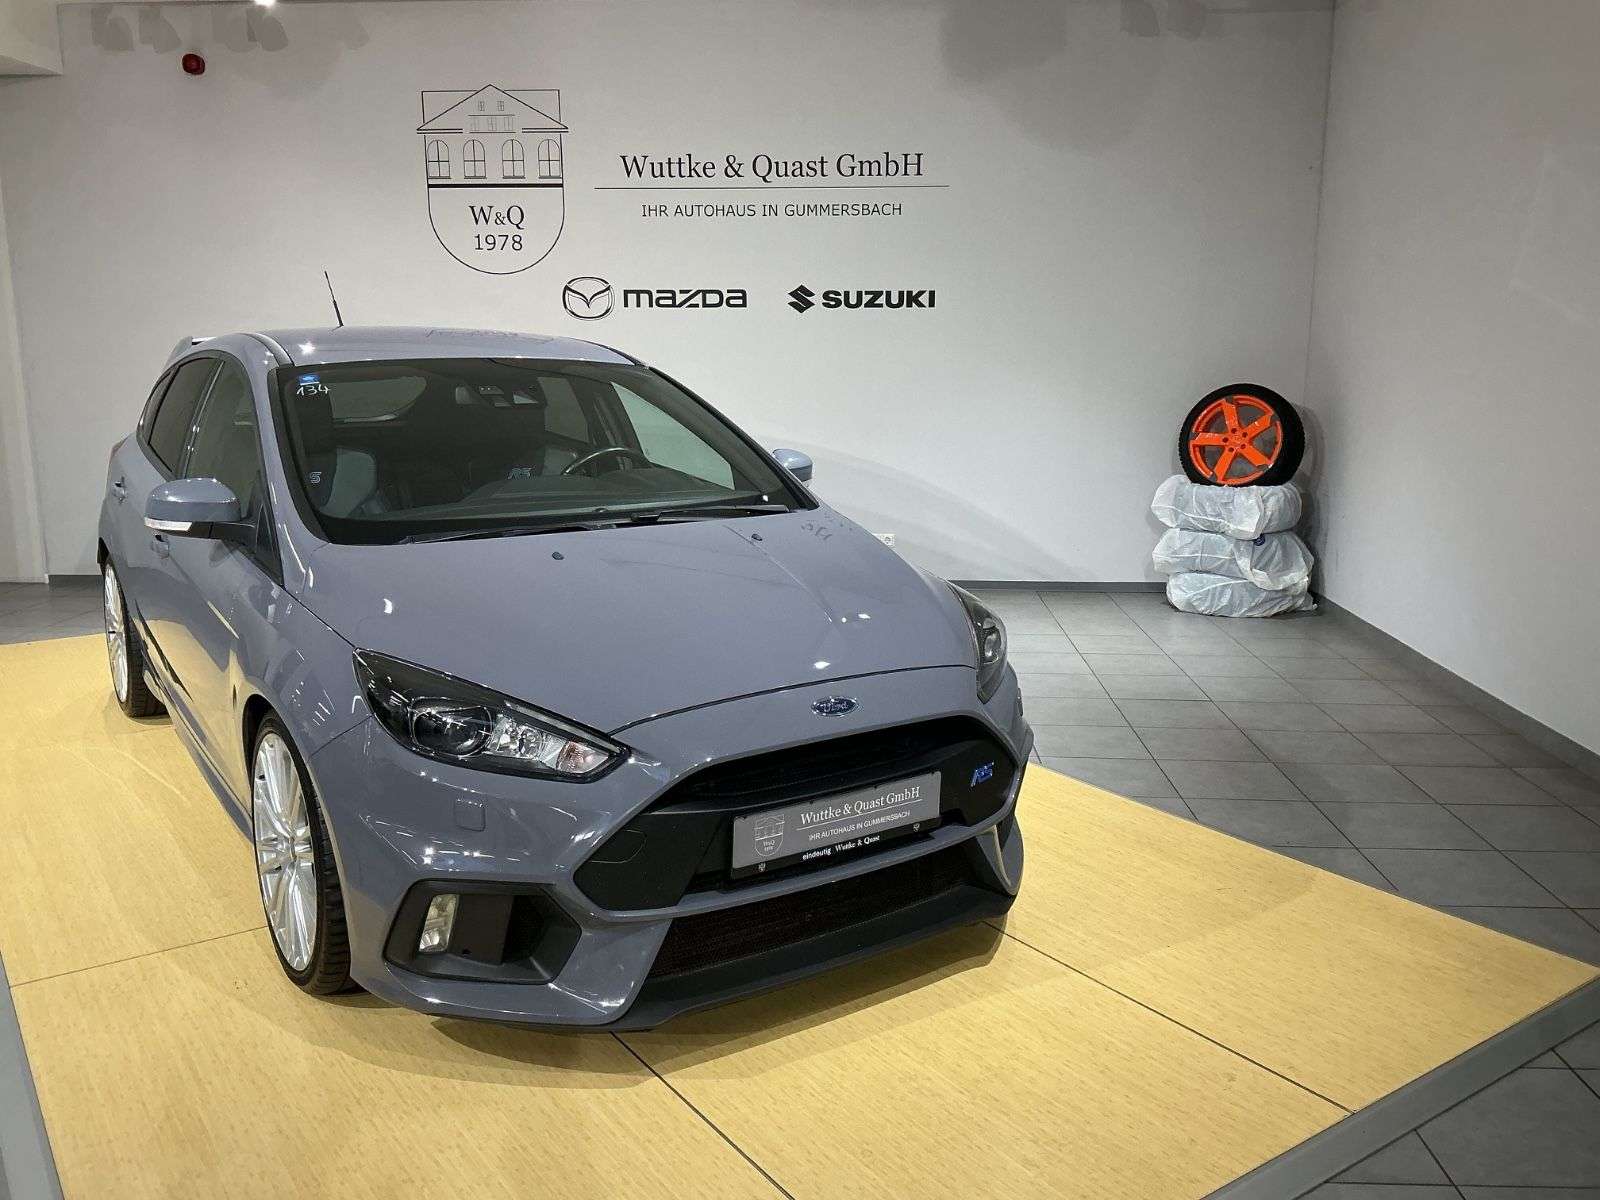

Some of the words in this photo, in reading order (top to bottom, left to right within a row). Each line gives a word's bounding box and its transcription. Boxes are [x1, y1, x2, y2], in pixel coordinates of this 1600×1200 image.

[617, 153, 717, 180] Wuttke
[724, 155, 744, 179] &
[752, 153, 829, 183] Quast
[836, 152, 924, 178] GmbH
[468, 204, 525, 230] W&Q
[641, 204, 668, 218] IHR
[673, 203, 756, 218] AUTOHAUS
[762, 203, 778, 217] IN
[784, 202, 903, 217] GUMMERSBACH
[473, 233, 524, 252] 1978
[822, 289, 936, 309] SUZUKI
[296, 384, 331, 396] 134
[800, 806, 842, 825] Wuttke
[842, 803, 852, 815] &
[854, 796, 884, 814] Quast
[886, 786, 920, 804] GmbH
[802, 846, 832, 861] eindeutig
